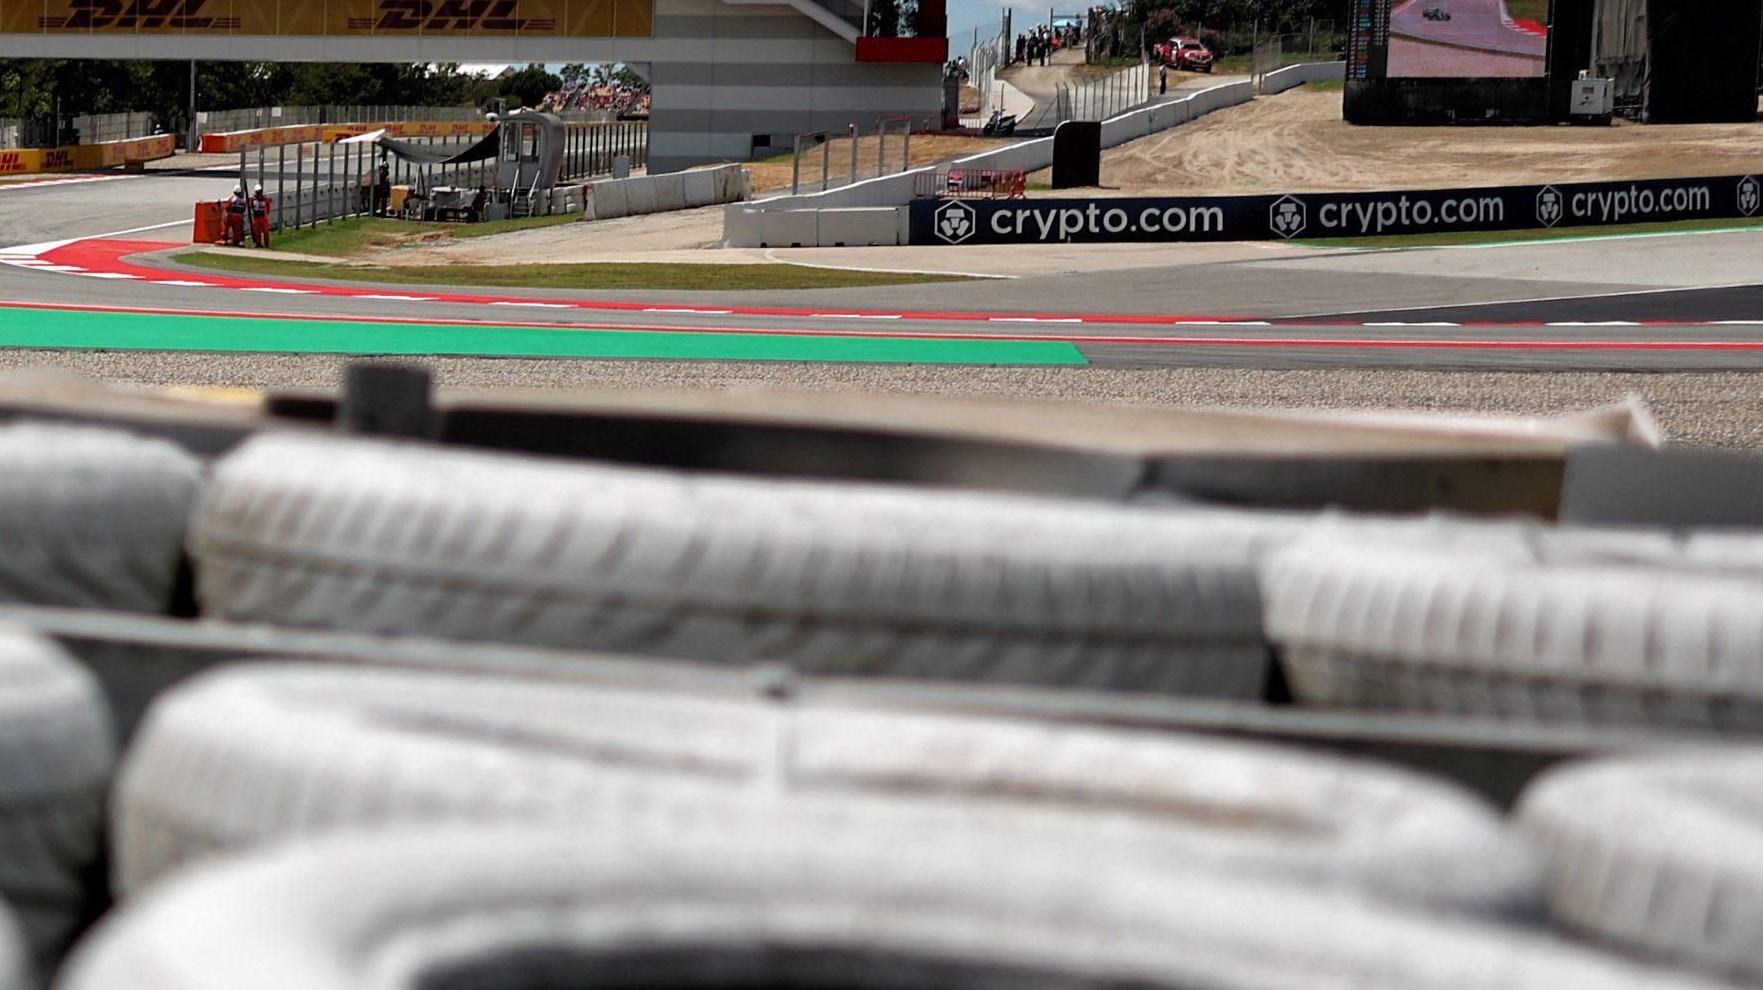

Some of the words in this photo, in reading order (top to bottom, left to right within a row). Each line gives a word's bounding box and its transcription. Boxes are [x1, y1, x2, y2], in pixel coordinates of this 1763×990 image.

[379, 0, 528, 29] DHL
[47, 150, 71, 169] DHL
[1319, 195, 1504, 233] crypto.com
[1572, 185, 1710, 221] crypto.com
[991, 203, 1224, 240] crypto.com
